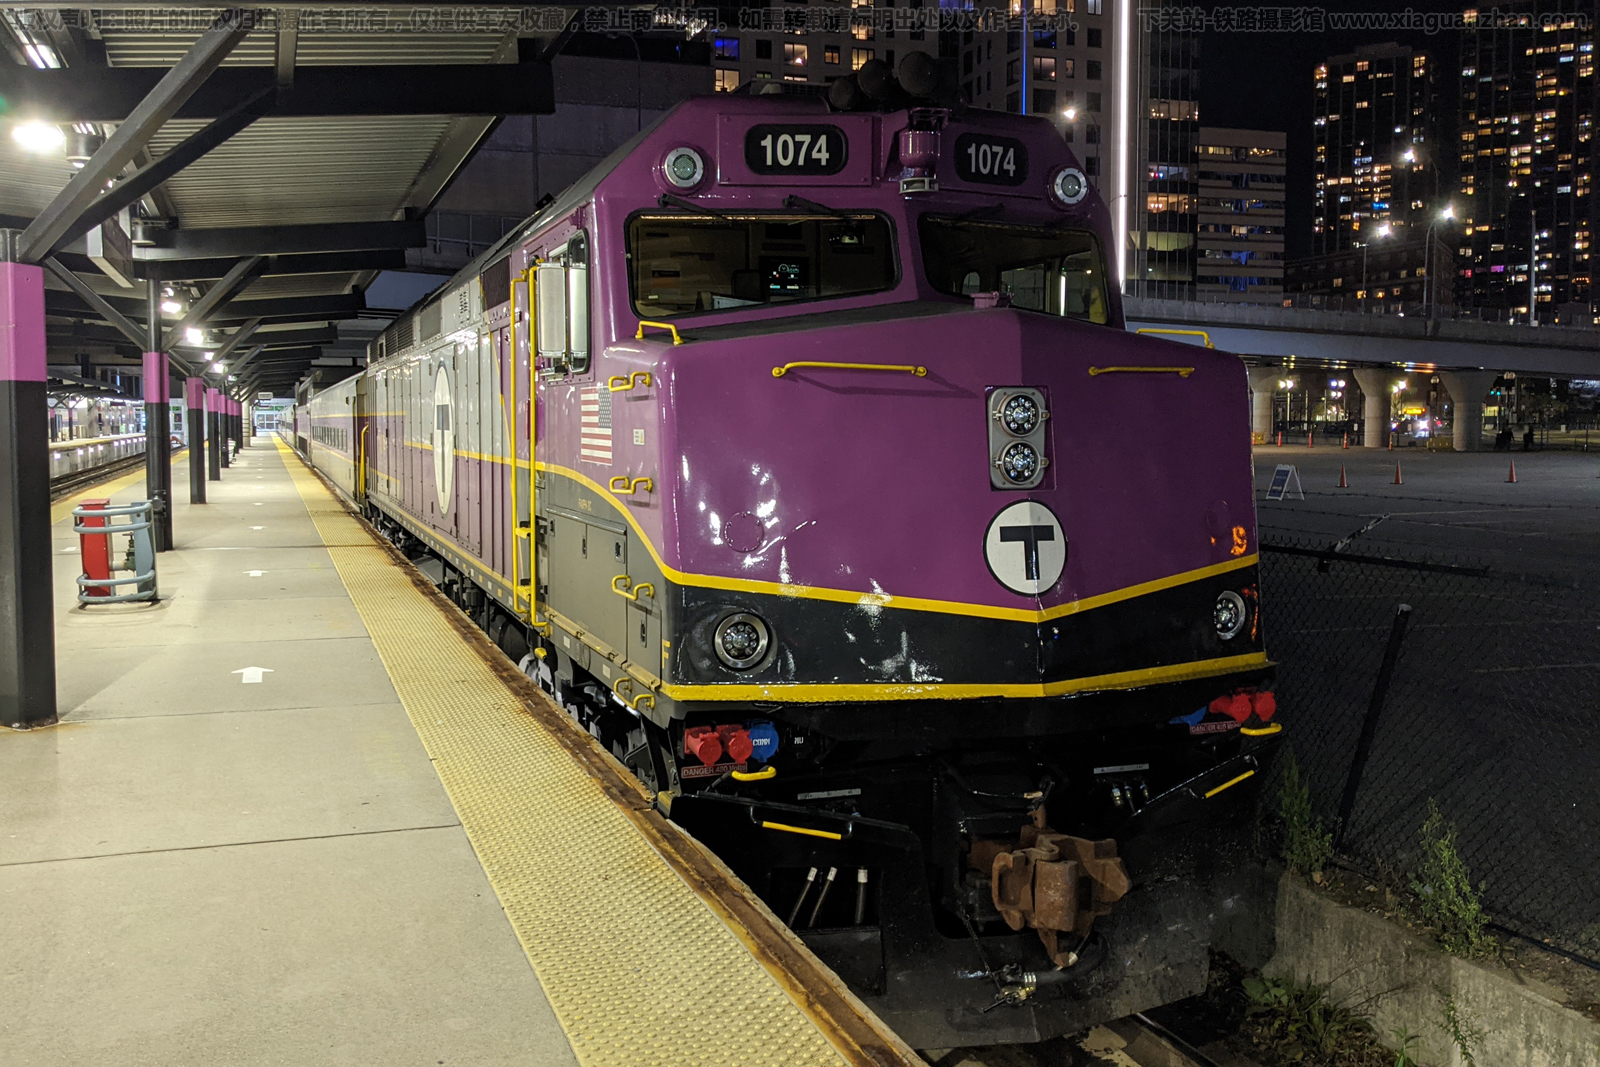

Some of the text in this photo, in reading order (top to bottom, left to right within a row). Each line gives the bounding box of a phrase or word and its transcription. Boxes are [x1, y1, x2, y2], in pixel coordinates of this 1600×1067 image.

[760, 134, 830, 166] 1074
[967, 142, 1016, 177] 1074
[999, 525, 1055, 580] T
[661, 639, 671, 669] F
[683, 766, 714, 777] DANGER
[715, 765, 728, 773] 480
